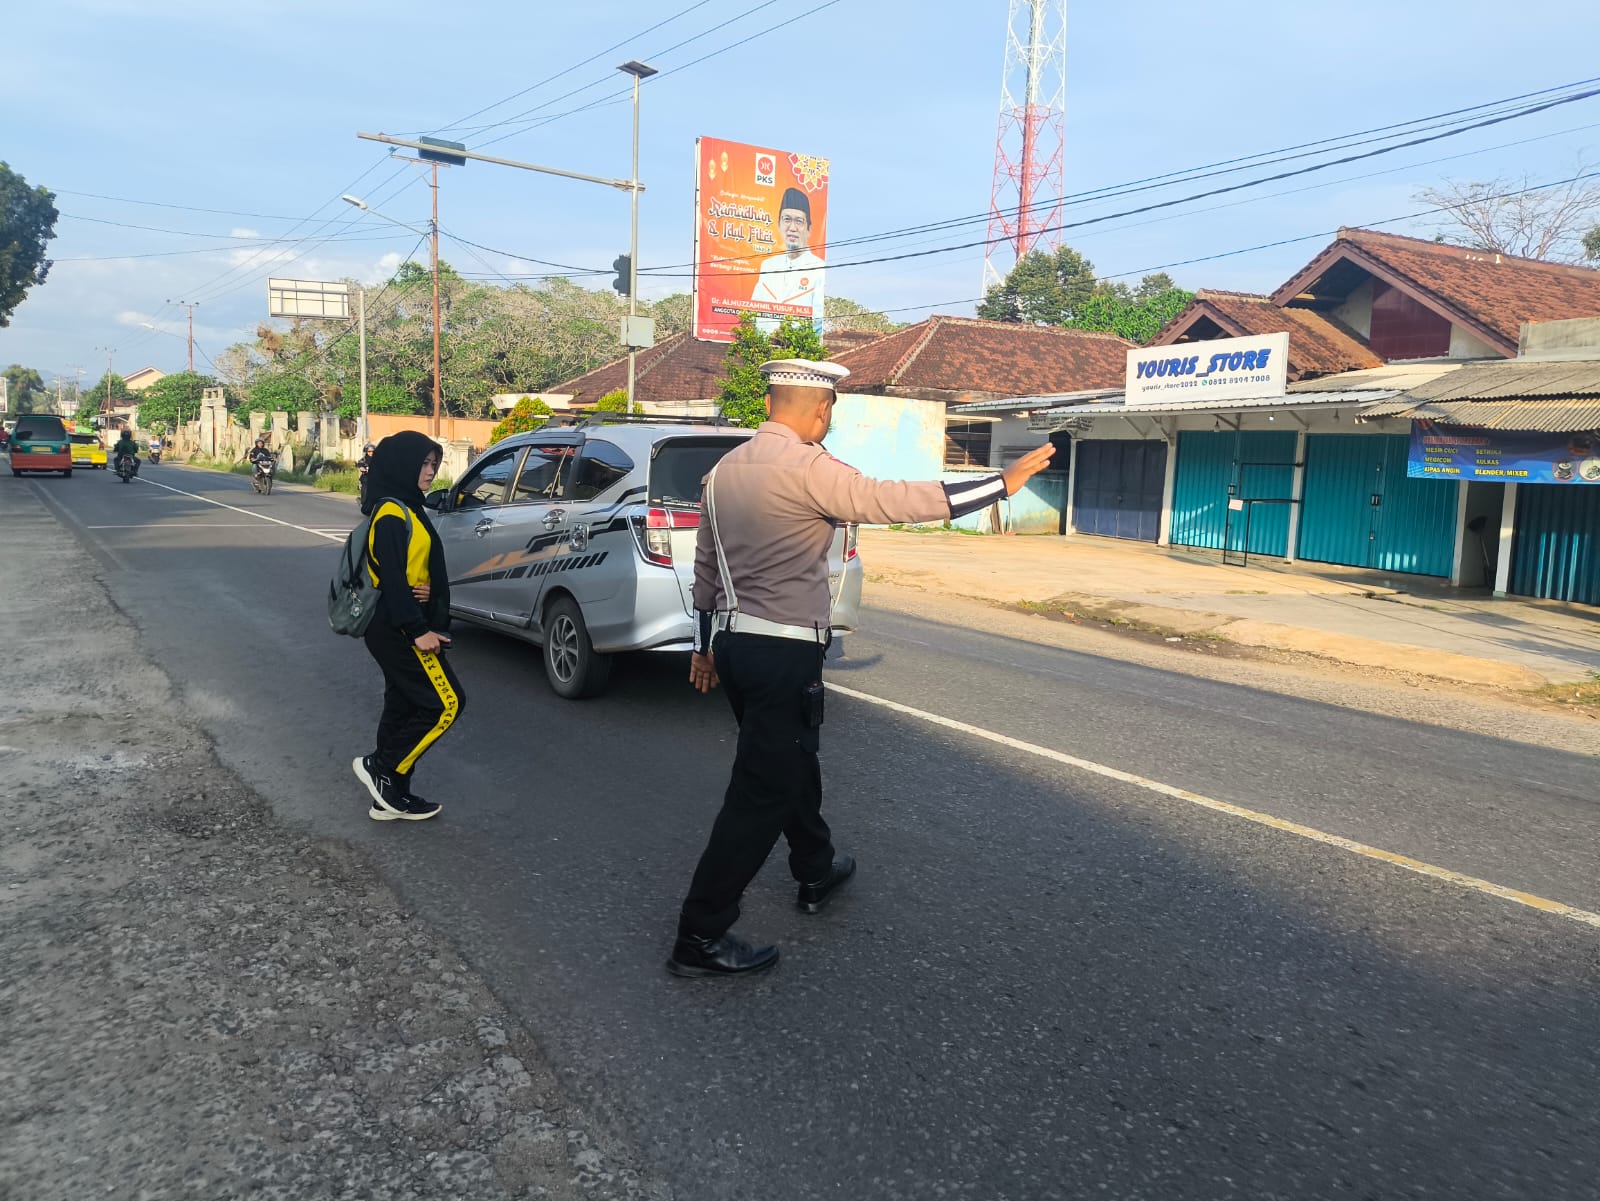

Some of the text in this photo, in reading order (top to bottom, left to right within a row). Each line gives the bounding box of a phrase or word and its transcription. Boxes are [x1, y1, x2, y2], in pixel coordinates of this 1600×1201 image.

[756, 175, 773, 184] PKS
[708, 197, 773, 226] Ramadhan
[708, 221, 719, 236] &
[723, 221, 746, 242] Idul
[1208, 377, 1227, 386] 0822
